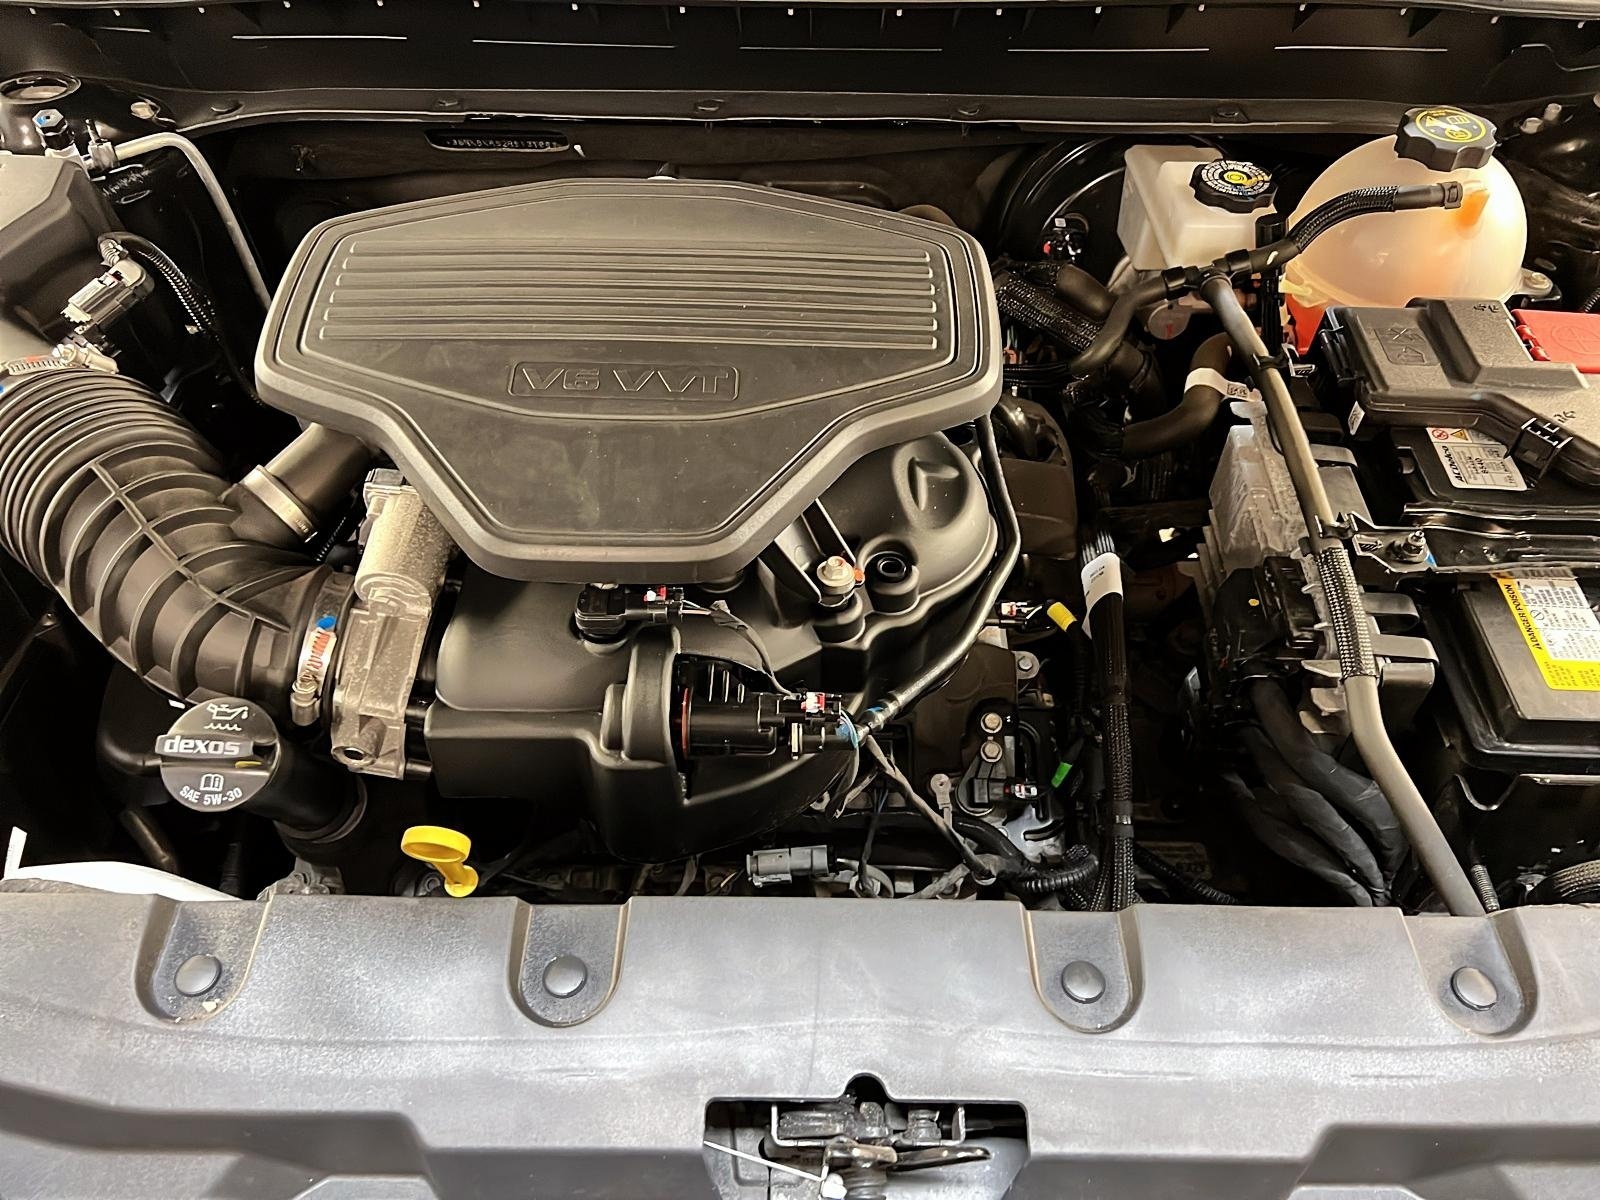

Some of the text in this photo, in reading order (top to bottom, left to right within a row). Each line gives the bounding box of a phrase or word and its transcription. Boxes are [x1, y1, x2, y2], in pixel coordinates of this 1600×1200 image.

[522, 368, 728, 393] V6 VVT
[164, 736, 241, 755] dexos
[180, 785, 242, 805] SAE 5W-30
